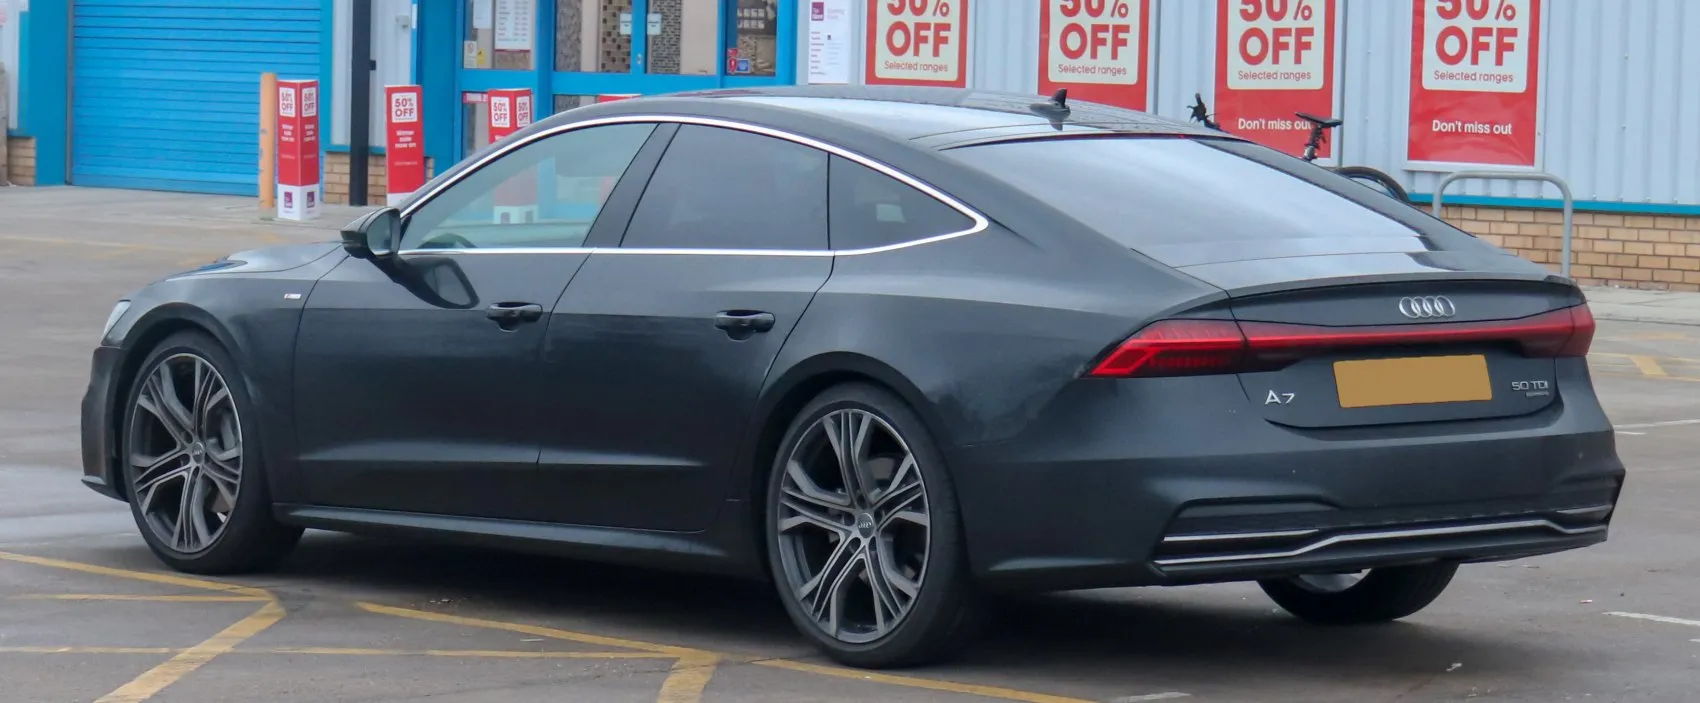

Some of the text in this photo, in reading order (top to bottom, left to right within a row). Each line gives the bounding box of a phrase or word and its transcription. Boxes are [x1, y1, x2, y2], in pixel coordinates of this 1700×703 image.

[886, 20, 952, 58] OFF
[1059, 22, 1130, 61] OFF
[1435, 25, 1518, 66] OFF
[1238, 27, 1315, 66] OFF
[884, 60, 949, 74] Selected ranges
[1057, 64, 1128, 77] Selected ranges
[1237, 70, 1312, 82] Selected ranges
[1433, 70, 1514, 84] Selected ranges
[395, 98, 414, 108] 50%
[395, 108, 415, 117] OFF
[493, 112, 508, 122] OFF
[1237, 118, 1266, 130] Don't
[1267, 119, 1292, 130] miss
[1432, 119, 1512, 135] Don't miss out
[1511, 380, 1549, 391] 50 TDI
[1264, 389, 1295, 405] A7
